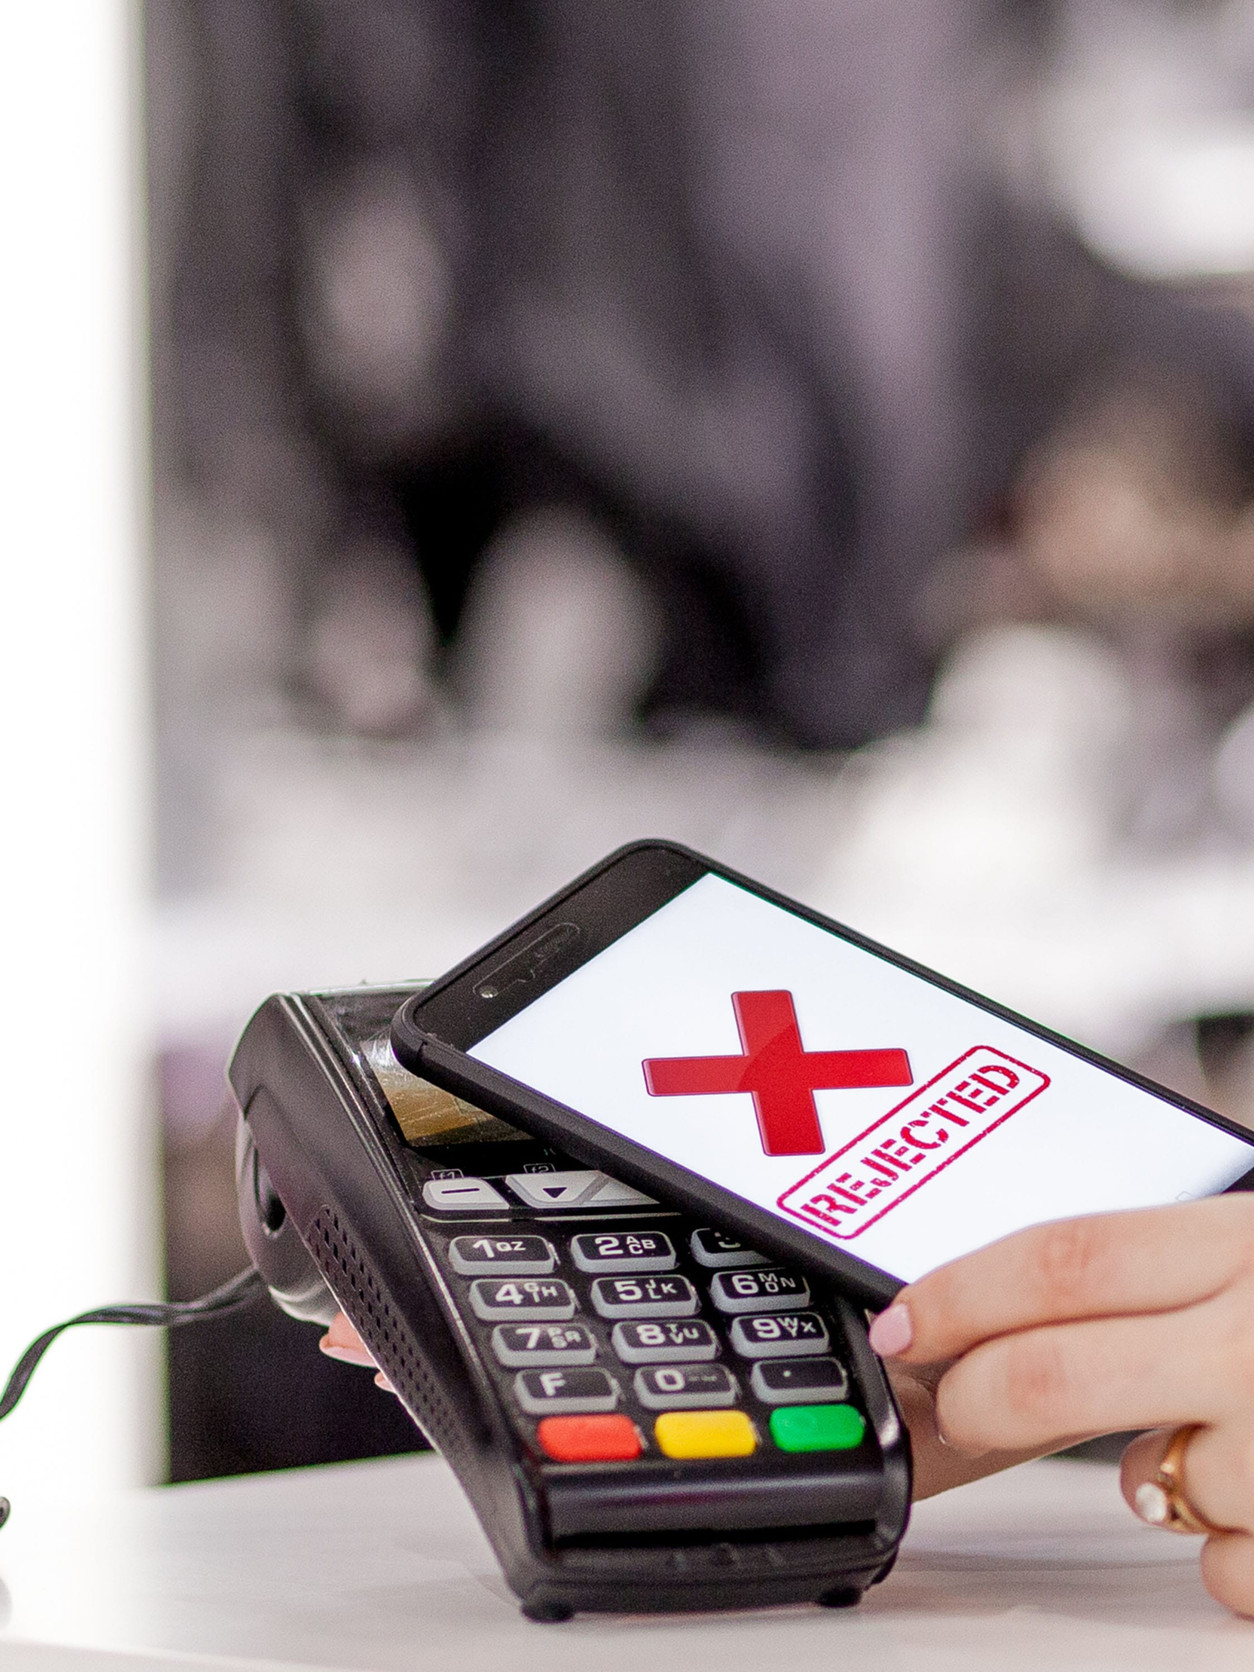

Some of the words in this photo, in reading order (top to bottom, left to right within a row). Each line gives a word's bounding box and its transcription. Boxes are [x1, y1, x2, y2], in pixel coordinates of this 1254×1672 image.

[800, 1064, 1020, 1226] REJECTED
[473, 1239, 495, 1258] 1
[594, 1236, 624, 1255] 2
[495, 1283, 524, 1304] 4
[614, 1280, 642, 1300] 5
[732, 1274, 759, 1294] 6
[515, 1327, 541, 1349] 7
[636, 1324, 666, 1345] 8
[752, 1318, 781, 1338] 9
[540, 1372, 566, 1396] F
